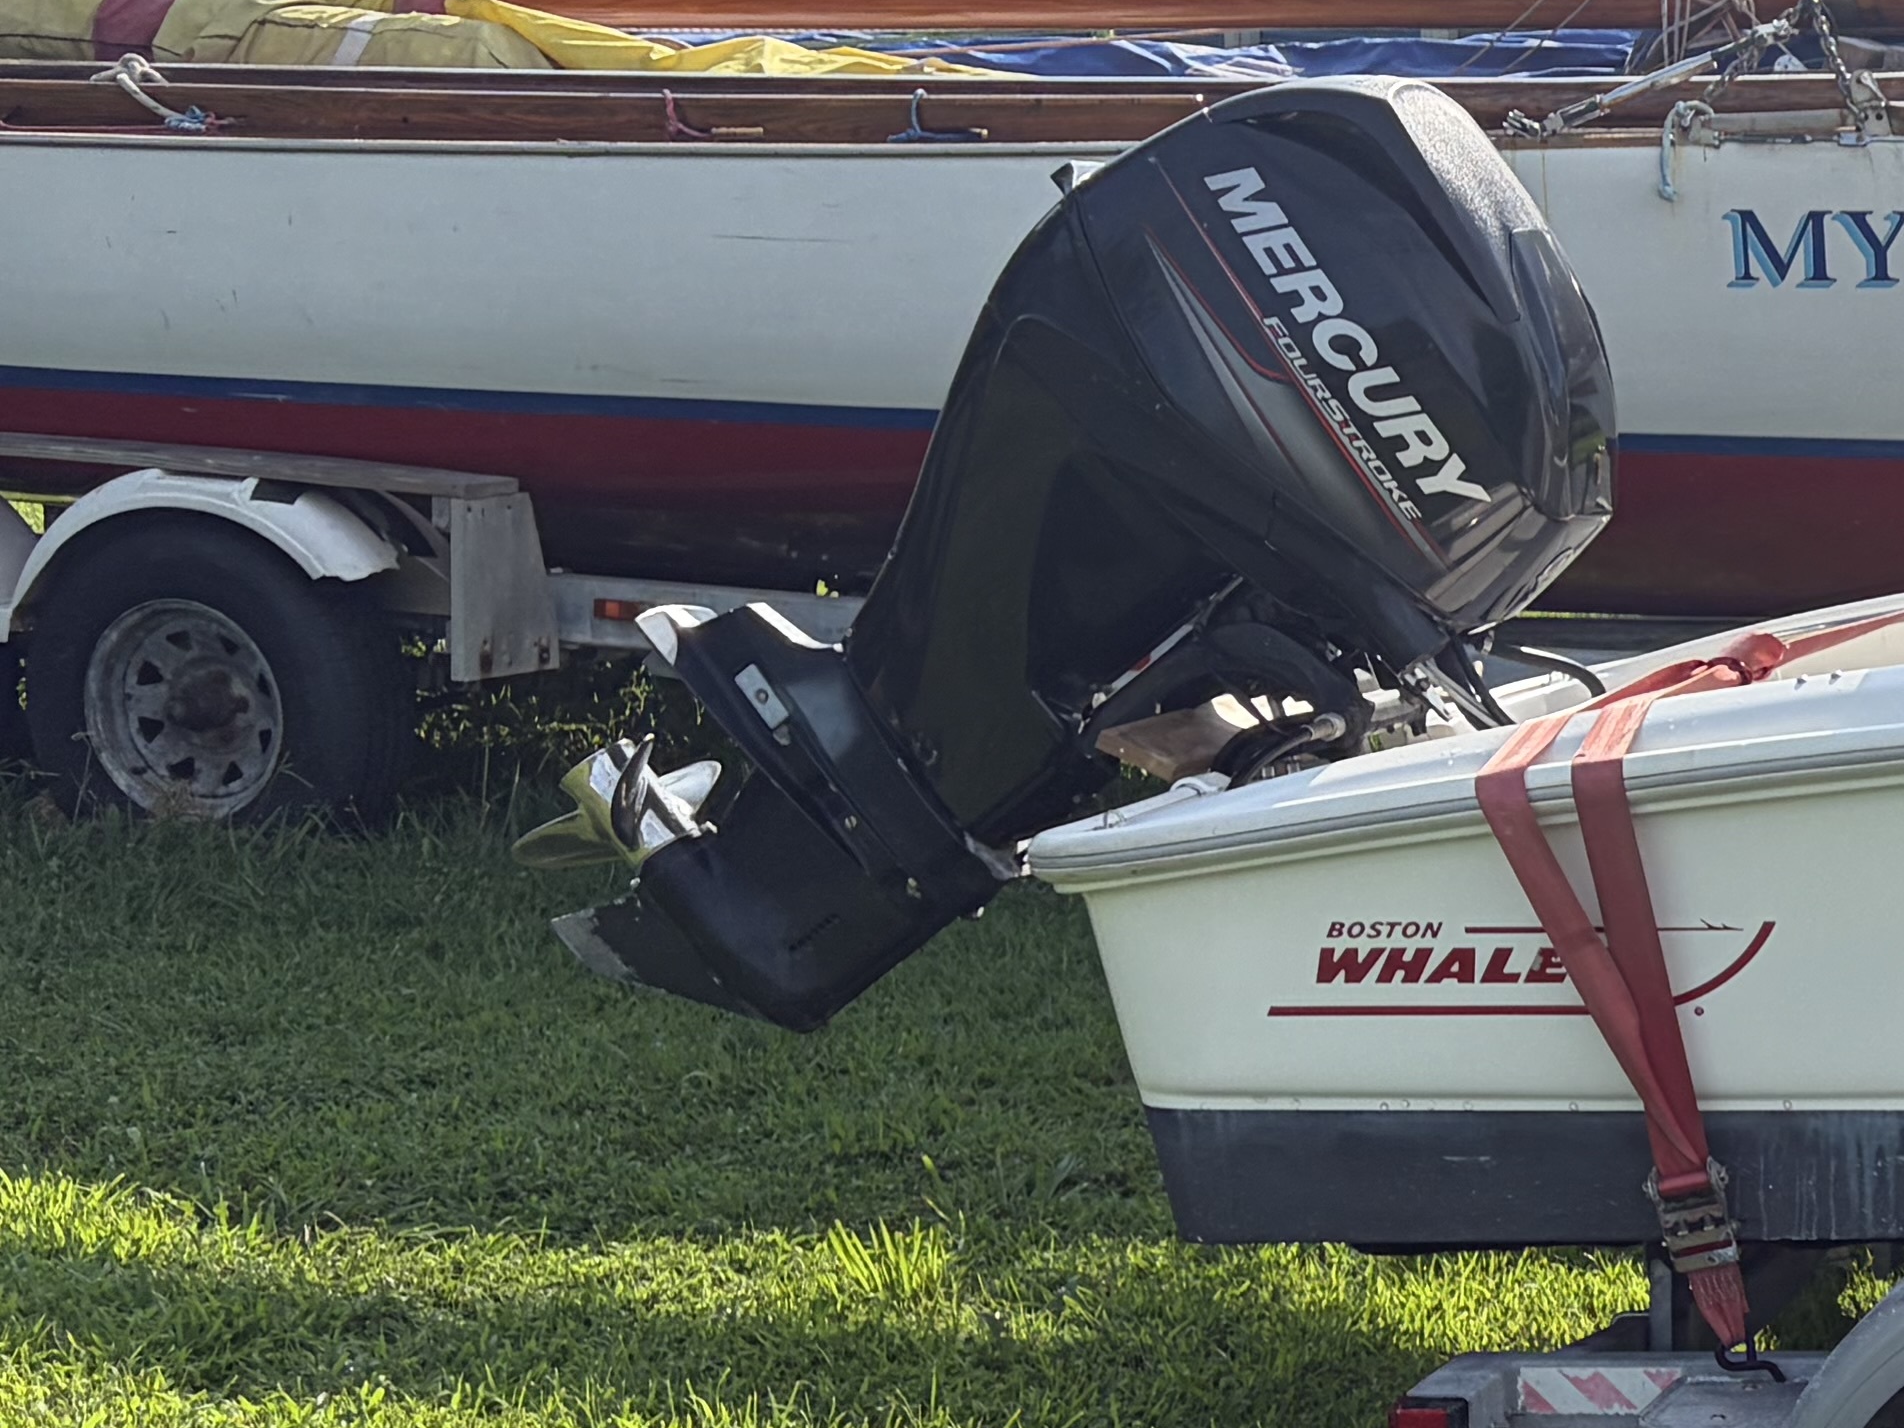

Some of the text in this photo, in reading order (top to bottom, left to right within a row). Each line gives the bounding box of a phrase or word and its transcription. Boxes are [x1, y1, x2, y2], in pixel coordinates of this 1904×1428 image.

[1203, 166, 1491, 504] MERCURY
[1263, 315, 1423, 523] FOURSTROKE
[1315, 946, 1567, 985] WHALE
[1326, 920, 1443, 940] BOSTON
